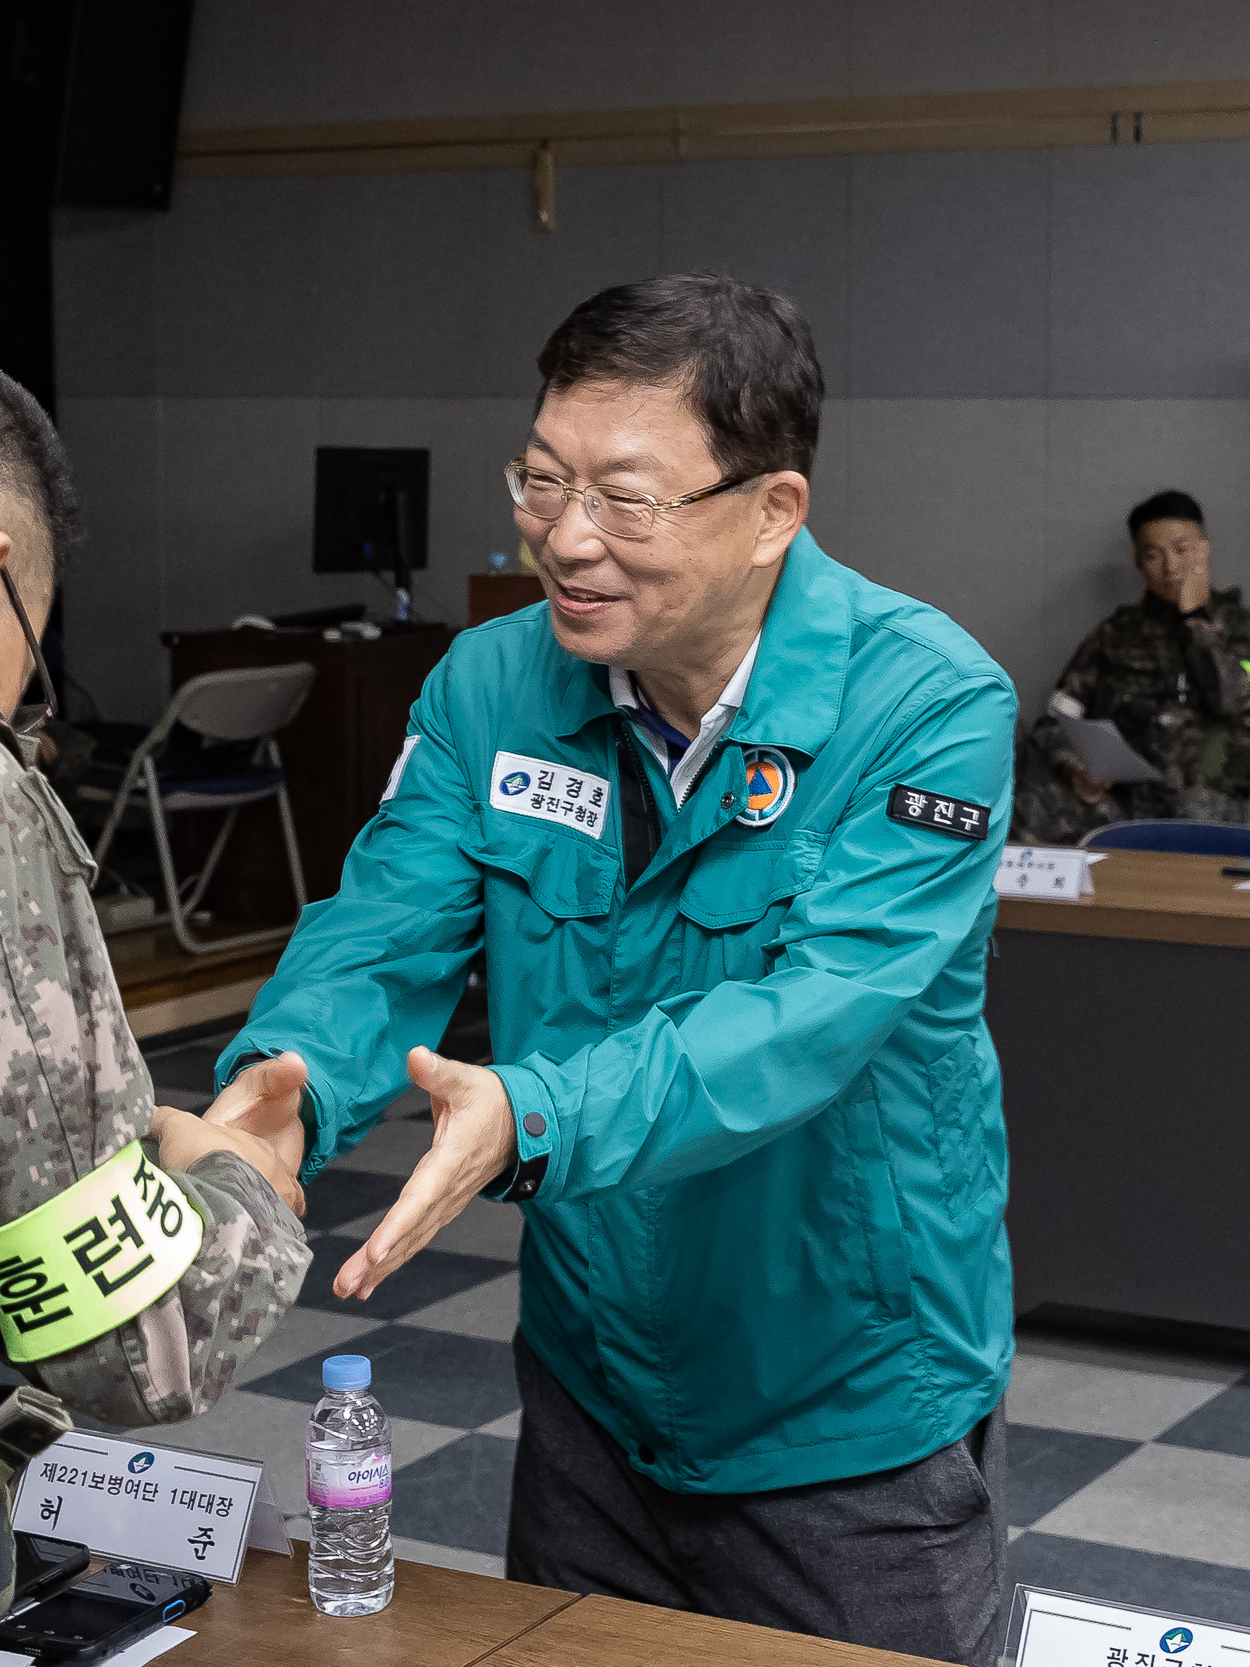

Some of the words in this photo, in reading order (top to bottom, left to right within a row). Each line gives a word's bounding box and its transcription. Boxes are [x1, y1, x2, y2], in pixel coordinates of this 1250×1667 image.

[530, 792, 598, 828] 광진구청장
[39, 1462, 159, 1503] 제221보병여단
[169, 1488, 234, 1518] 1대대장
[39, 1495, 63, 1531] 허
[187, 1526, 216, 1561] 준
